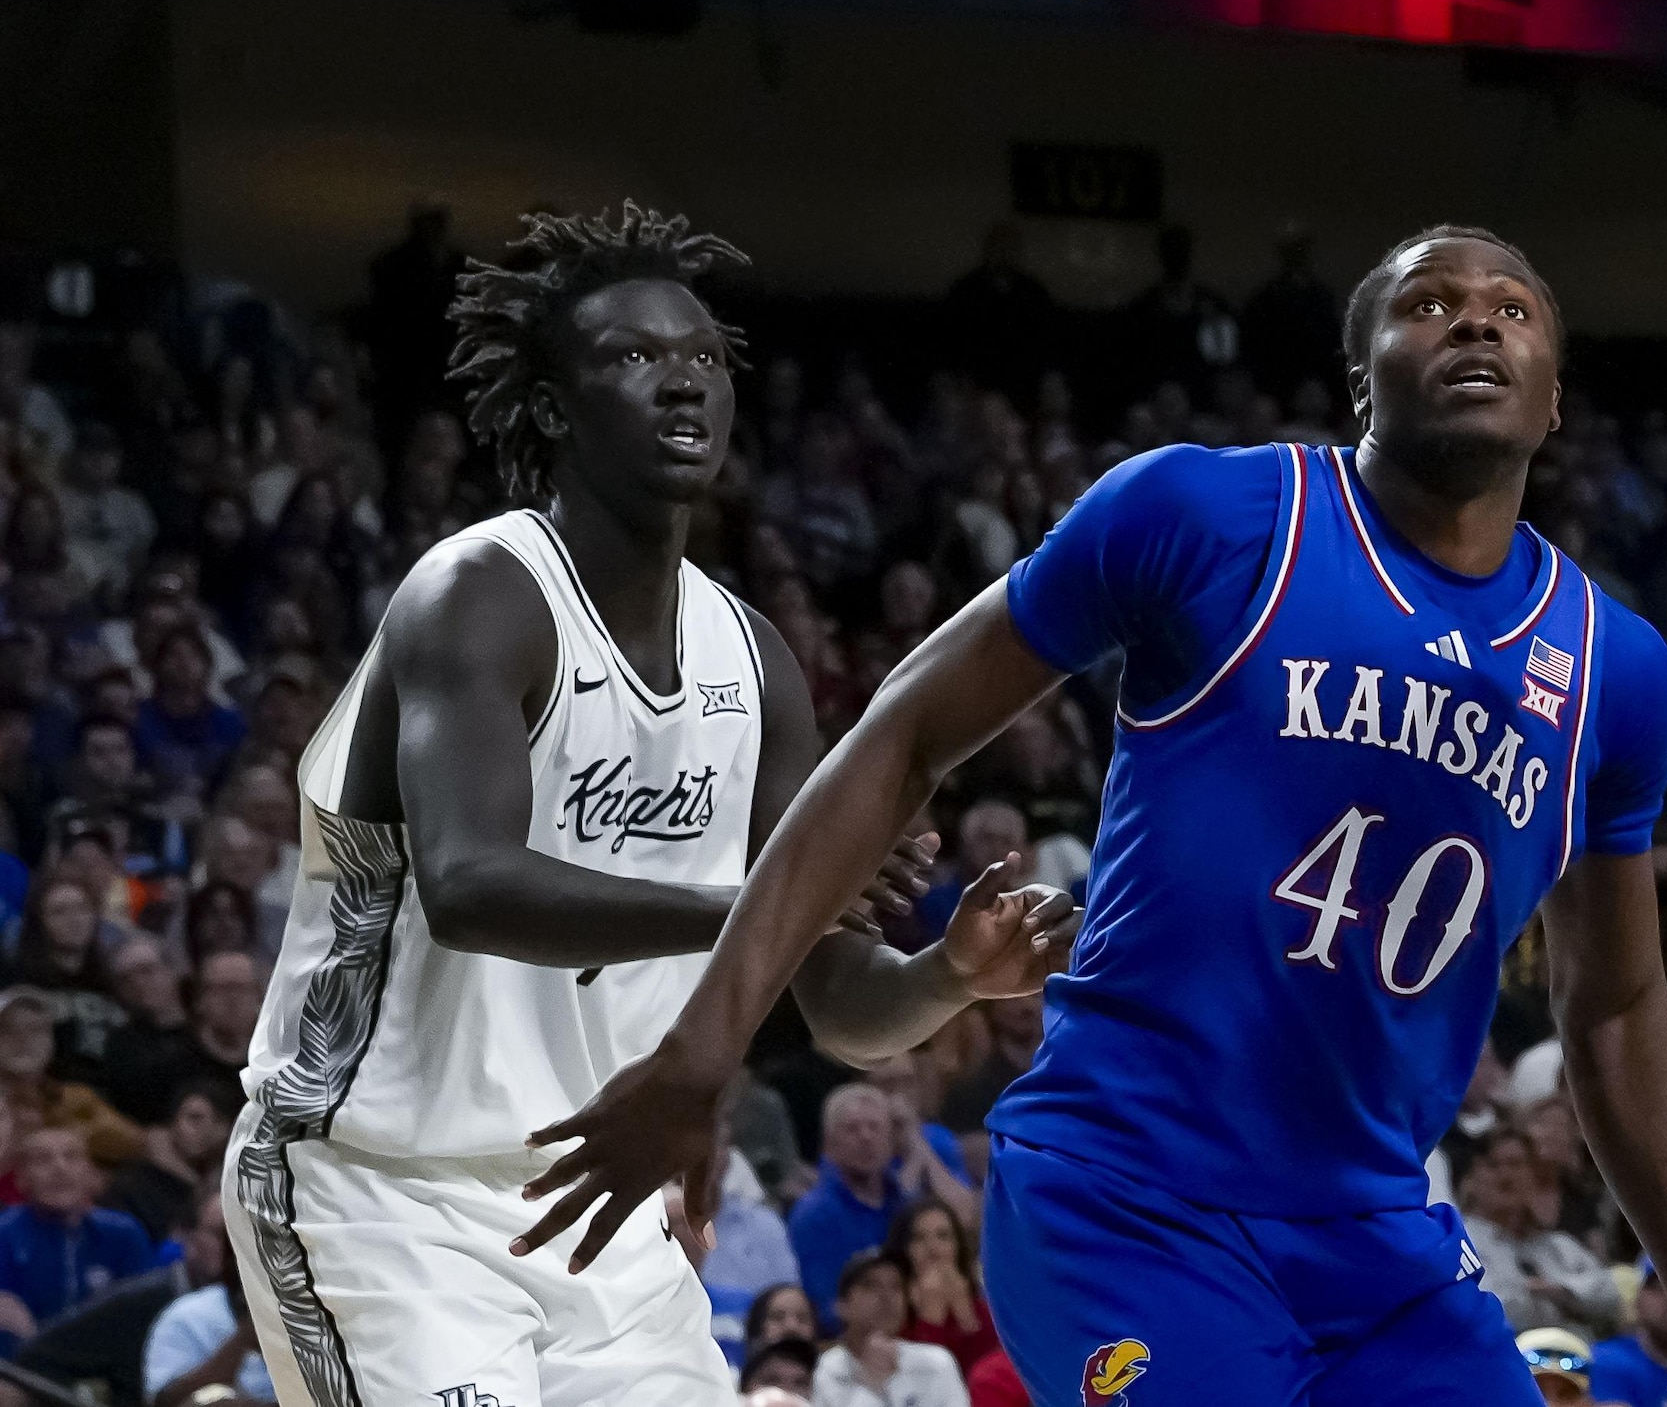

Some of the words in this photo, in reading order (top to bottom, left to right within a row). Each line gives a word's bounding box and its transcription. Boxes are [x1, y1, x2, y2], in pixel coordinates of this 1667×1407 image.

[697, 682, 750, 717] XII
[1279, 659, 1548, 830] KANSAS
[557, 755, 718, 855] Knights
[1275, 805, 1486, 996] 40
